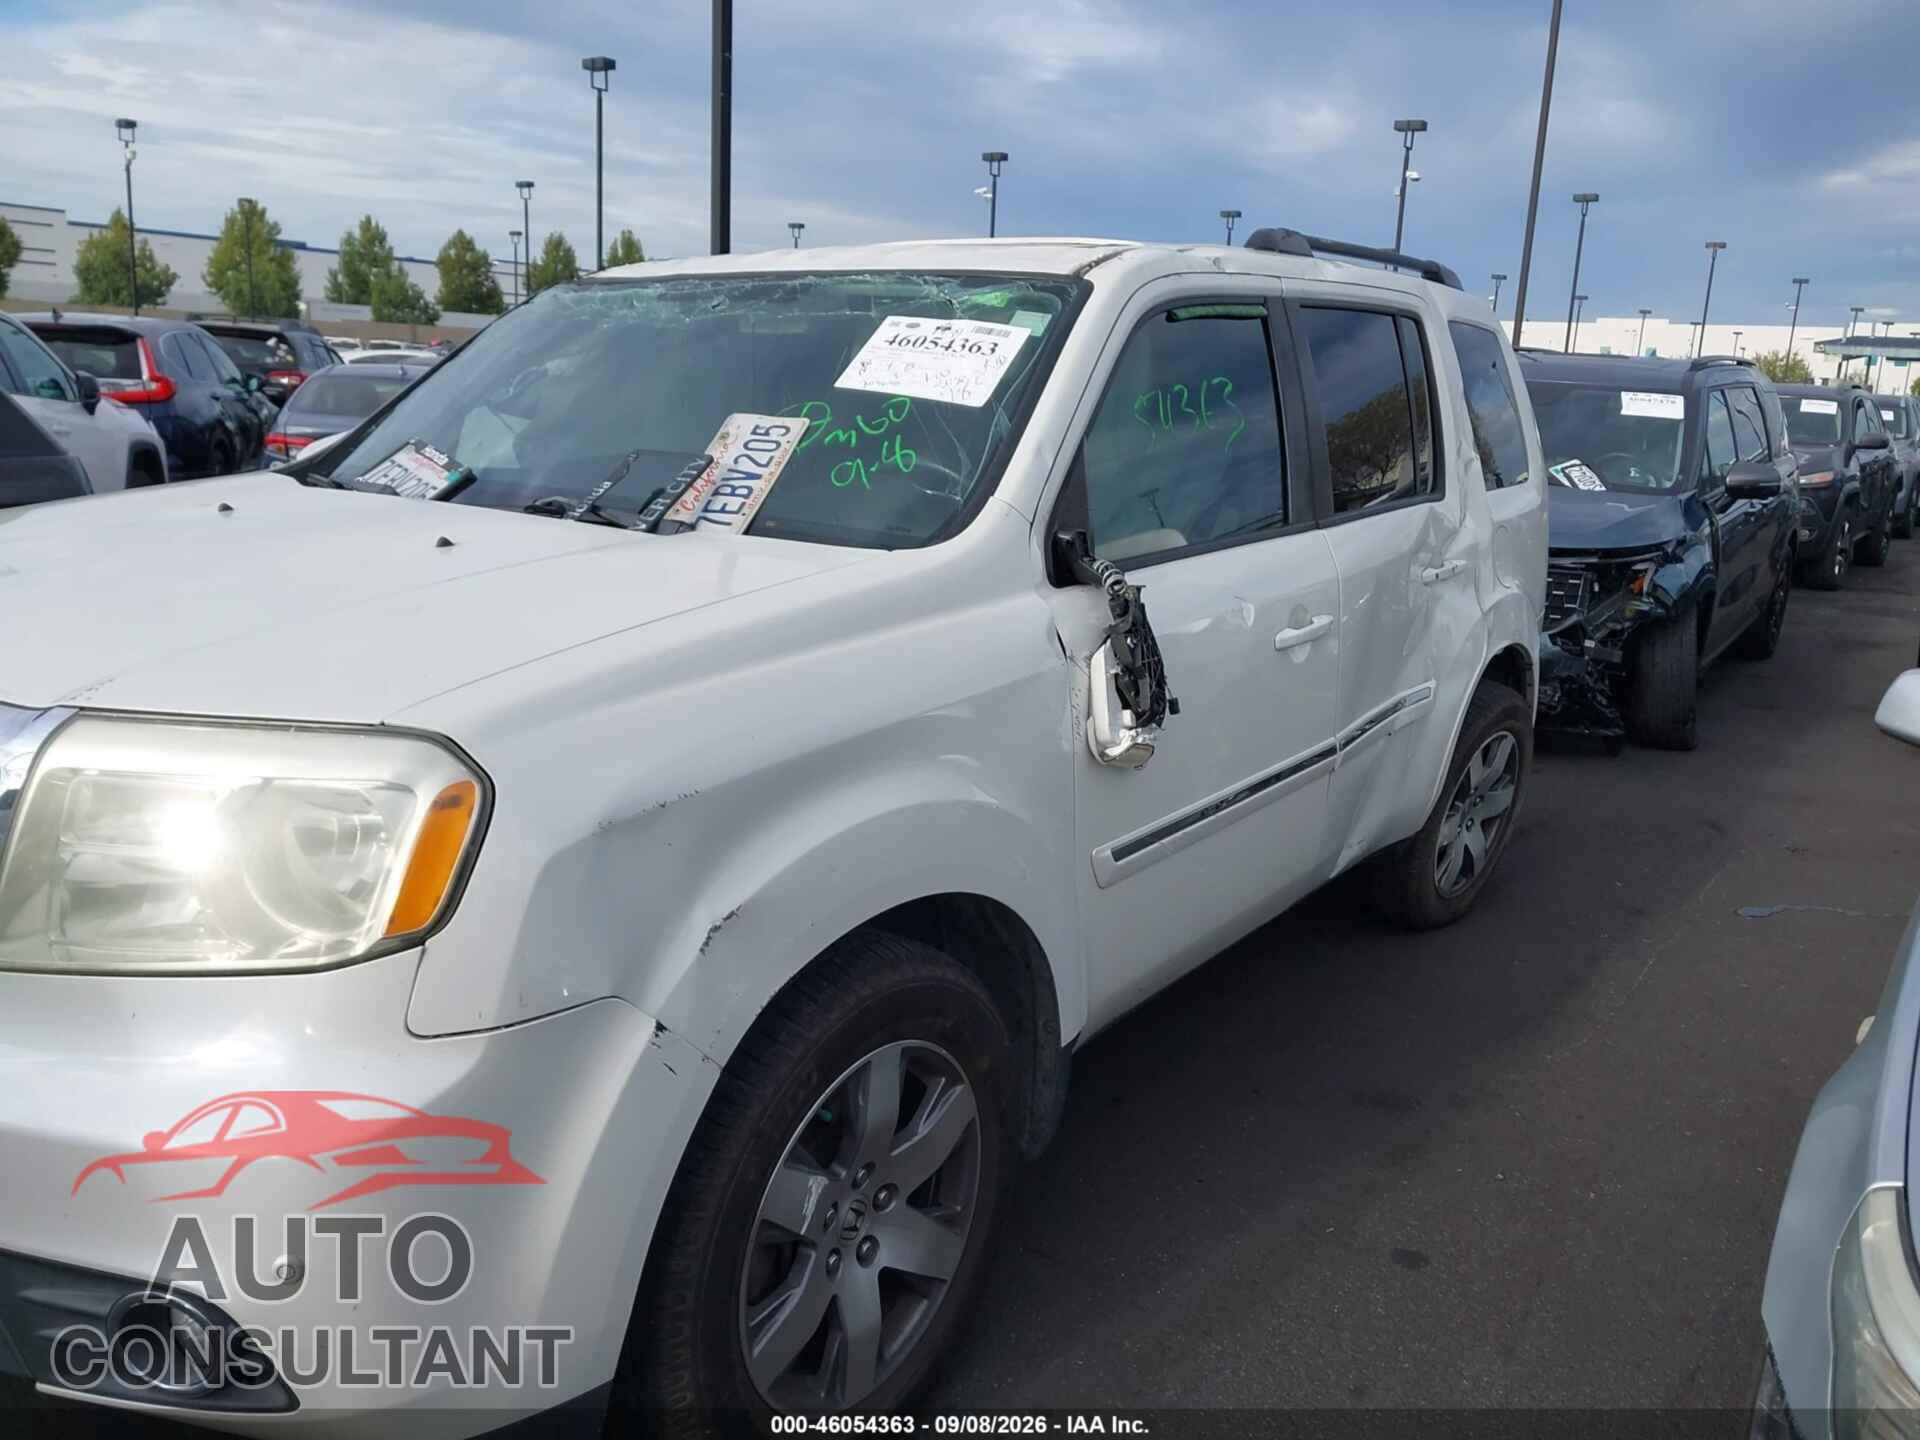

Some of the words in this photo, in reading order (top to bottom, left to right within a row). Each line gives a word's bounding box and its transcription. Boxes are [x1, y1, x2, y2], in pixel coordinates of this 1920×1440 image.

[884, 332, 999, 357] 46054363
[667, 457, 705, 493] CITY
[700, 424, 791, 526] 7EBV205
